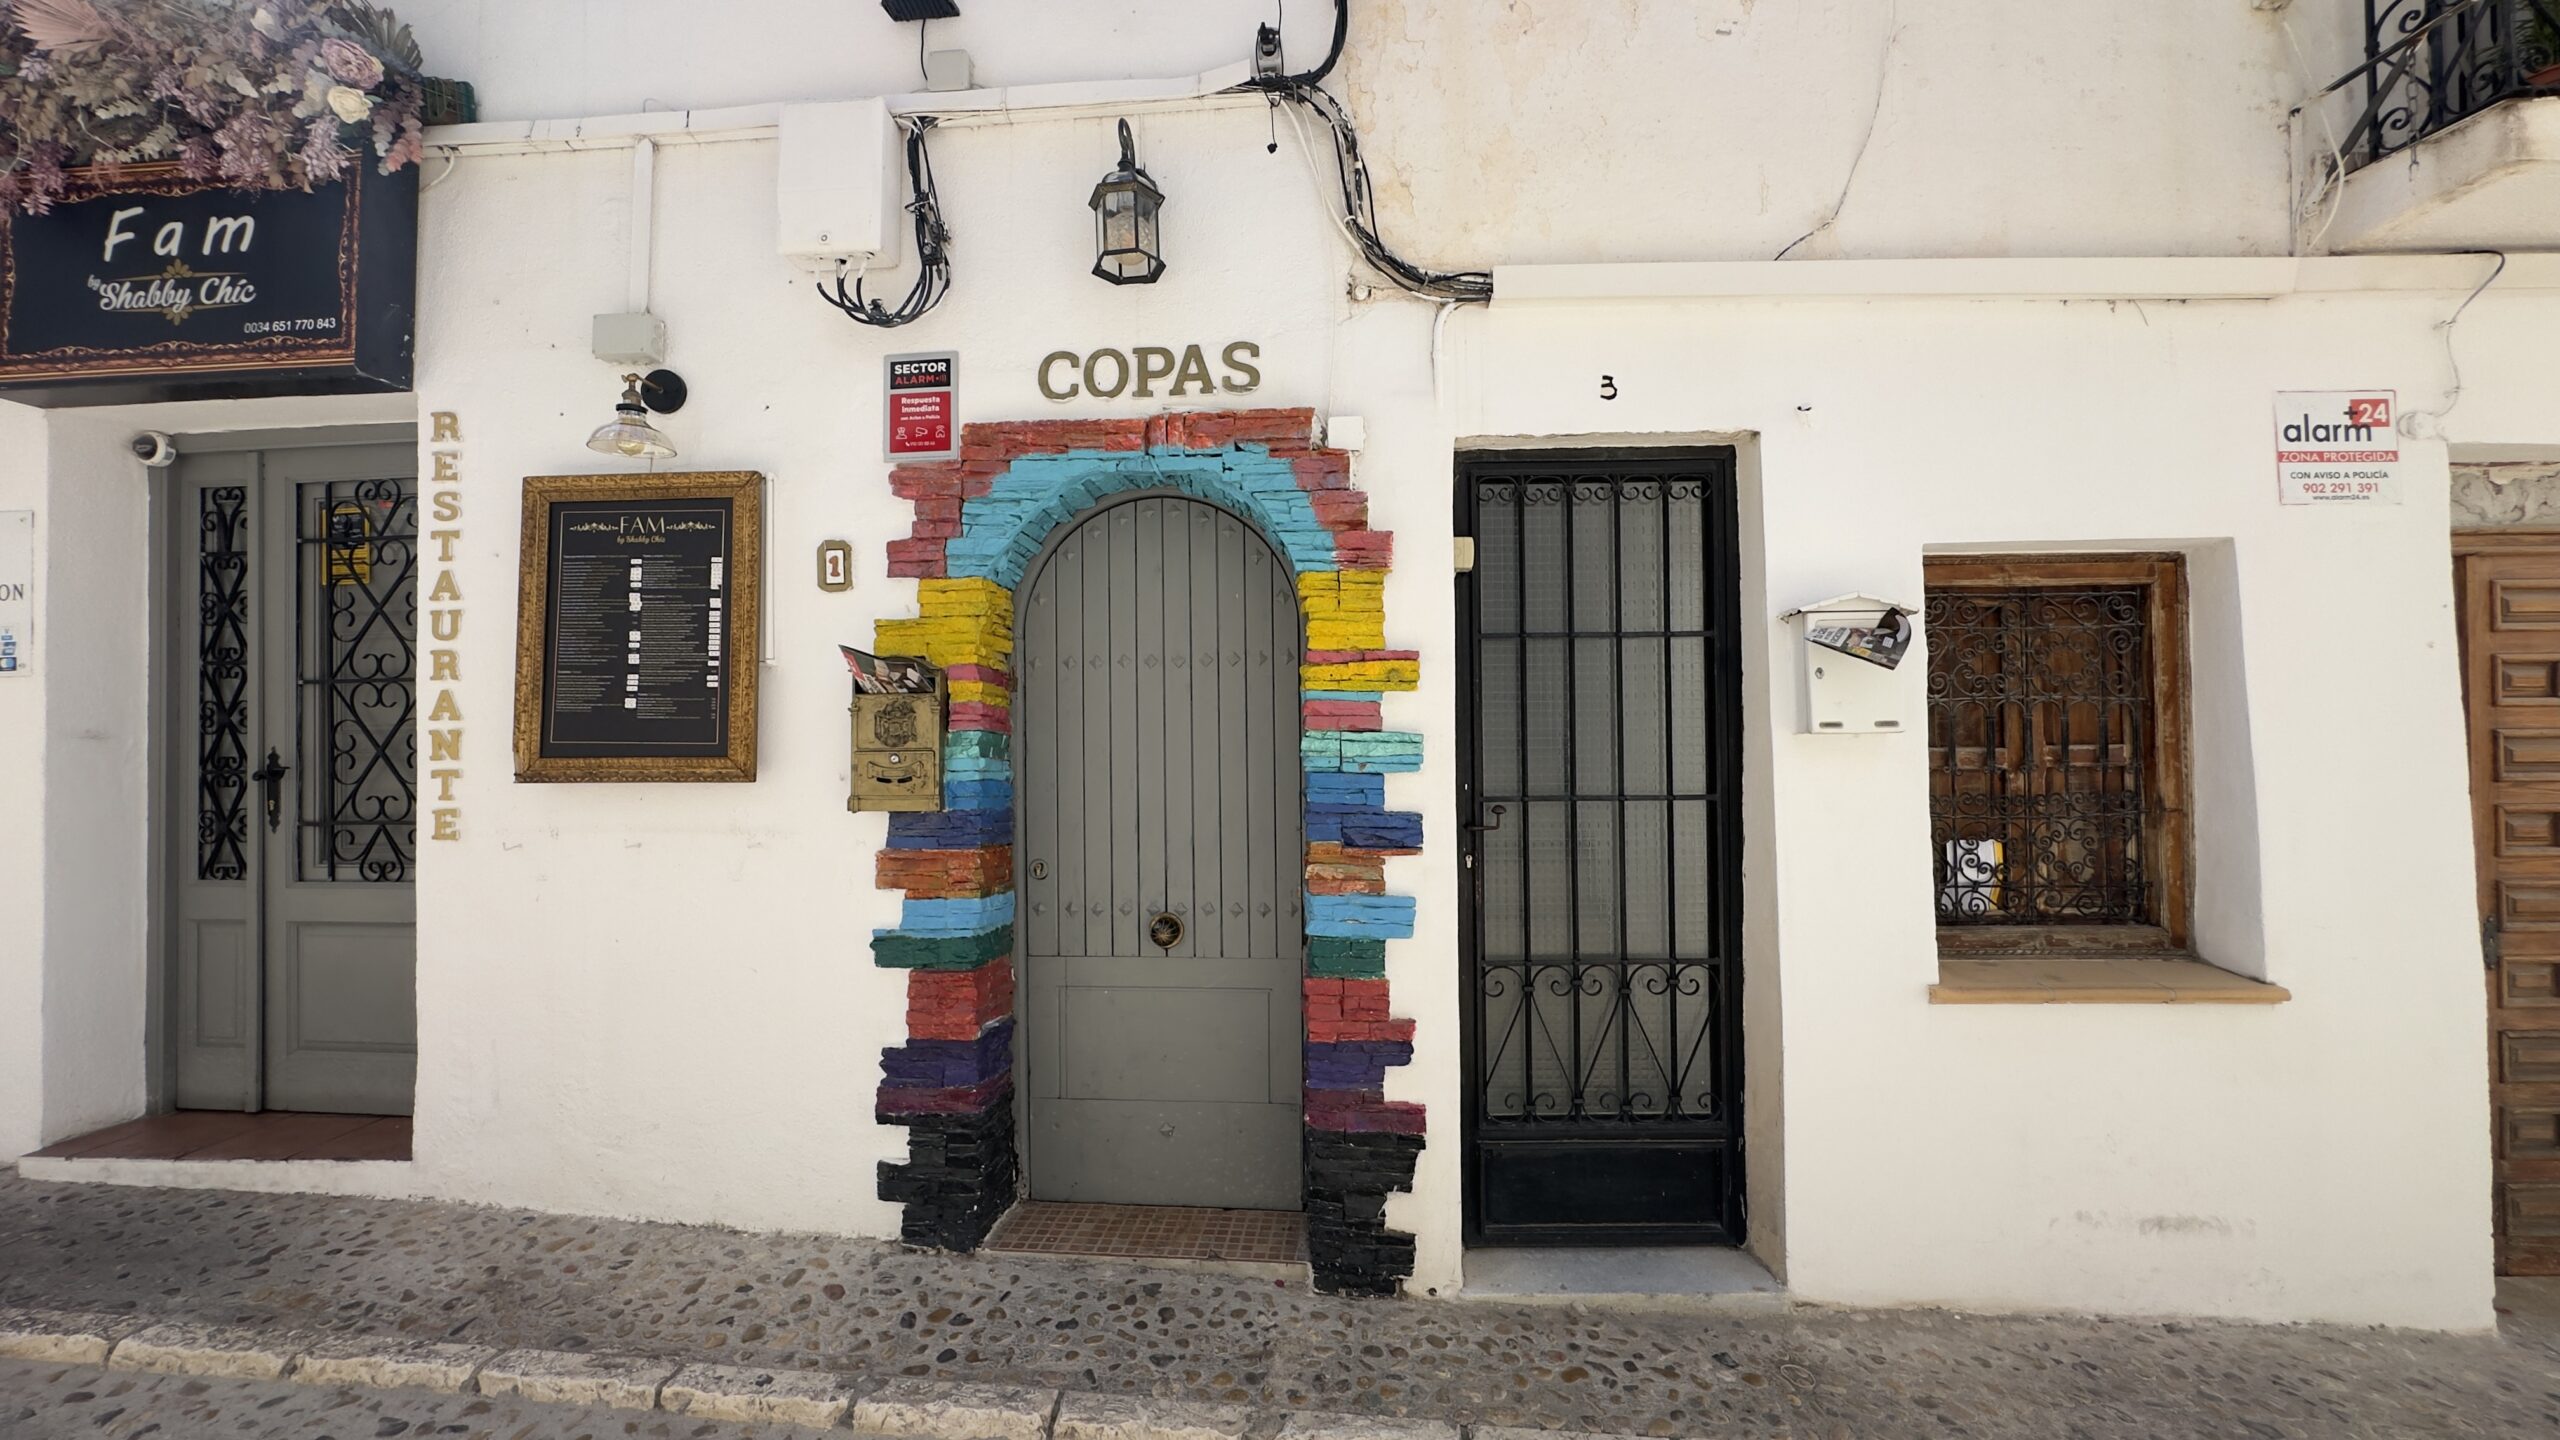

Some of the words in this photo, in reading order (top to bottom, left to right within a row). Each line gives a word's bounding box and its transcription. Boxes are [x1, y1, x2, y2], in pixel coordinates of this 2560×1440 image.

[104, 206, 255, 263] Fam
[88, 274, 101, 291] by
[100, 279, 193, 313] Shabby
[244, 321, 270, 334] 0034
[272, 320, 292, 332] 651
[295, 319, 314, 331] 770
[317, 317, 336, 330] 843
[894, 362, 947, 375] SECTOR
[1038, 341, 1261, 402] COPAS
[895, 375, 935, 385] ALARM
[1600, 374, 1618, 400] 3
[901, 396, 940, 405] Respuesta
[2283, 413, 2372, 442] alarm
[2281, 453, 2320, 462] ZONA
[2323, 452, 2396, 461] PROTEGIDA
[2290, 471, 2311, 479] CON
[2313, 471, 2341, 479] AVISO
[2343, 471, 2350, 479] A
[2352, 469, 2389, 479] POLICÍA
[2302, 483, 2326, 493] 902
[2330, 483, 2351, 493] 291
[2357, 483, 2379, 493] 391
[620, 516, 665, 534] FAM
[829, 555, 841, 577] 1
[429, 411, 464, 841] RESTAURANTE
